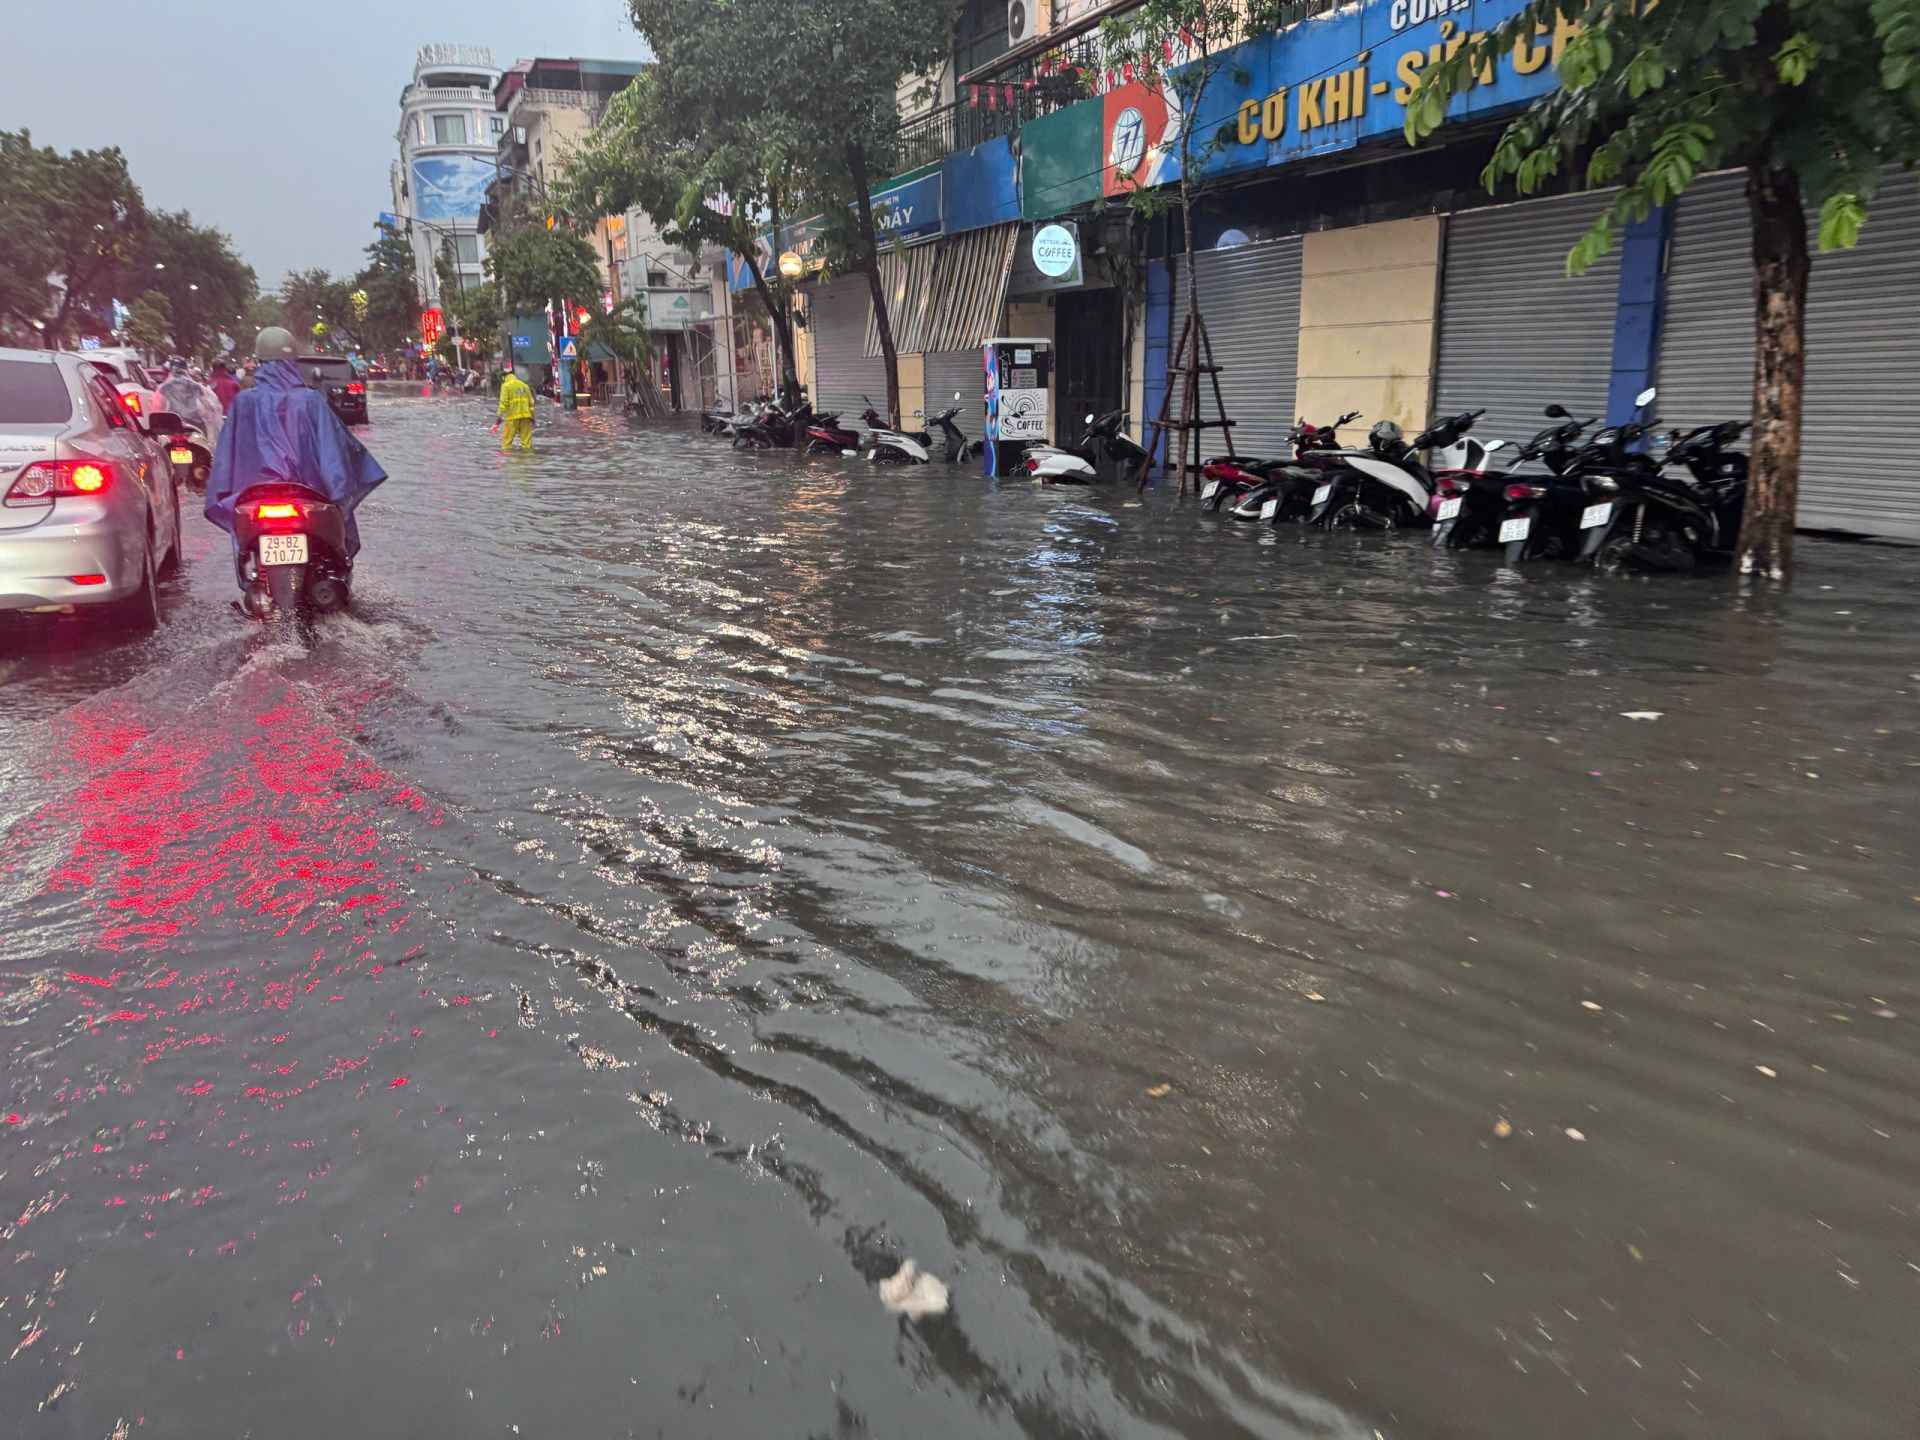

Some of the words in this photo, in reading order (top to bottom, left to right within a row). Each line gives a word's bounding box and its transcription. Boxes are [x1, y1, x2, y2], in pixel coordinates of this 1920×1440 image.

[1238, 86, 1287, 145] CƠ
[1038, 247, 1072, 258] COFFEE
[1017, 420, 1044, 431] COFFEE
[267, 536, 299, 549] 29-B2
[264, 549, 304, 563] 210.77
